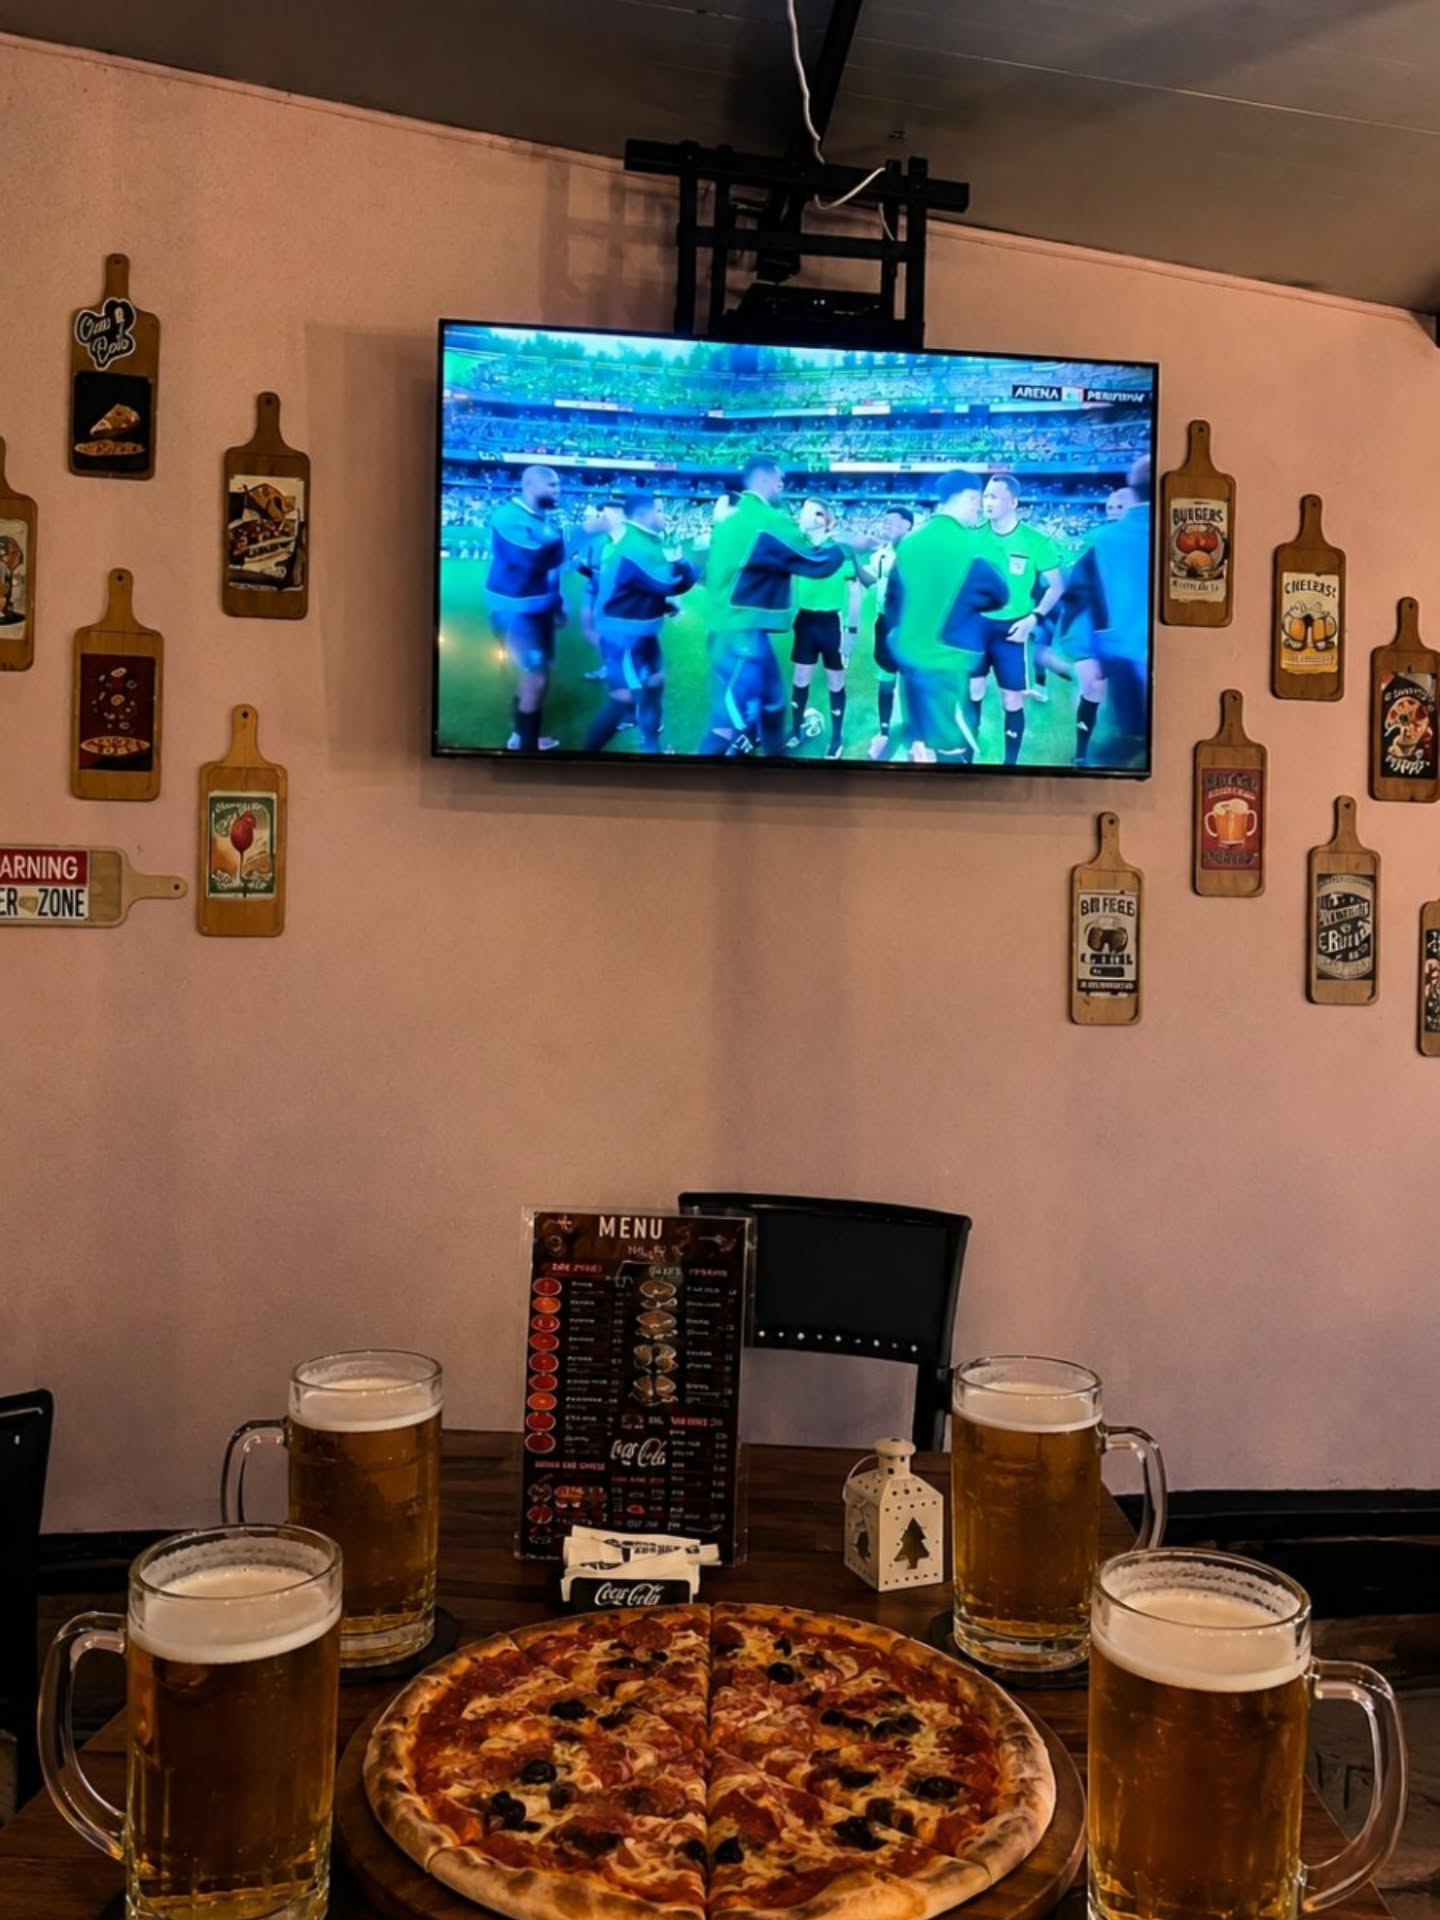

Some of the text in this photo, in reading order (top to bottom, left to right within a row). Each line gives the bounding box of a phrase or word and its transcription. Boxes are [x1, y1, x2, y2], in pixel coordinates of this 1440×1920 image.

[1014, 386, 1060, 400] ARENA
[37, 888, 85, 917] ZONE
[598, 1216, 663, 1240] MENU
